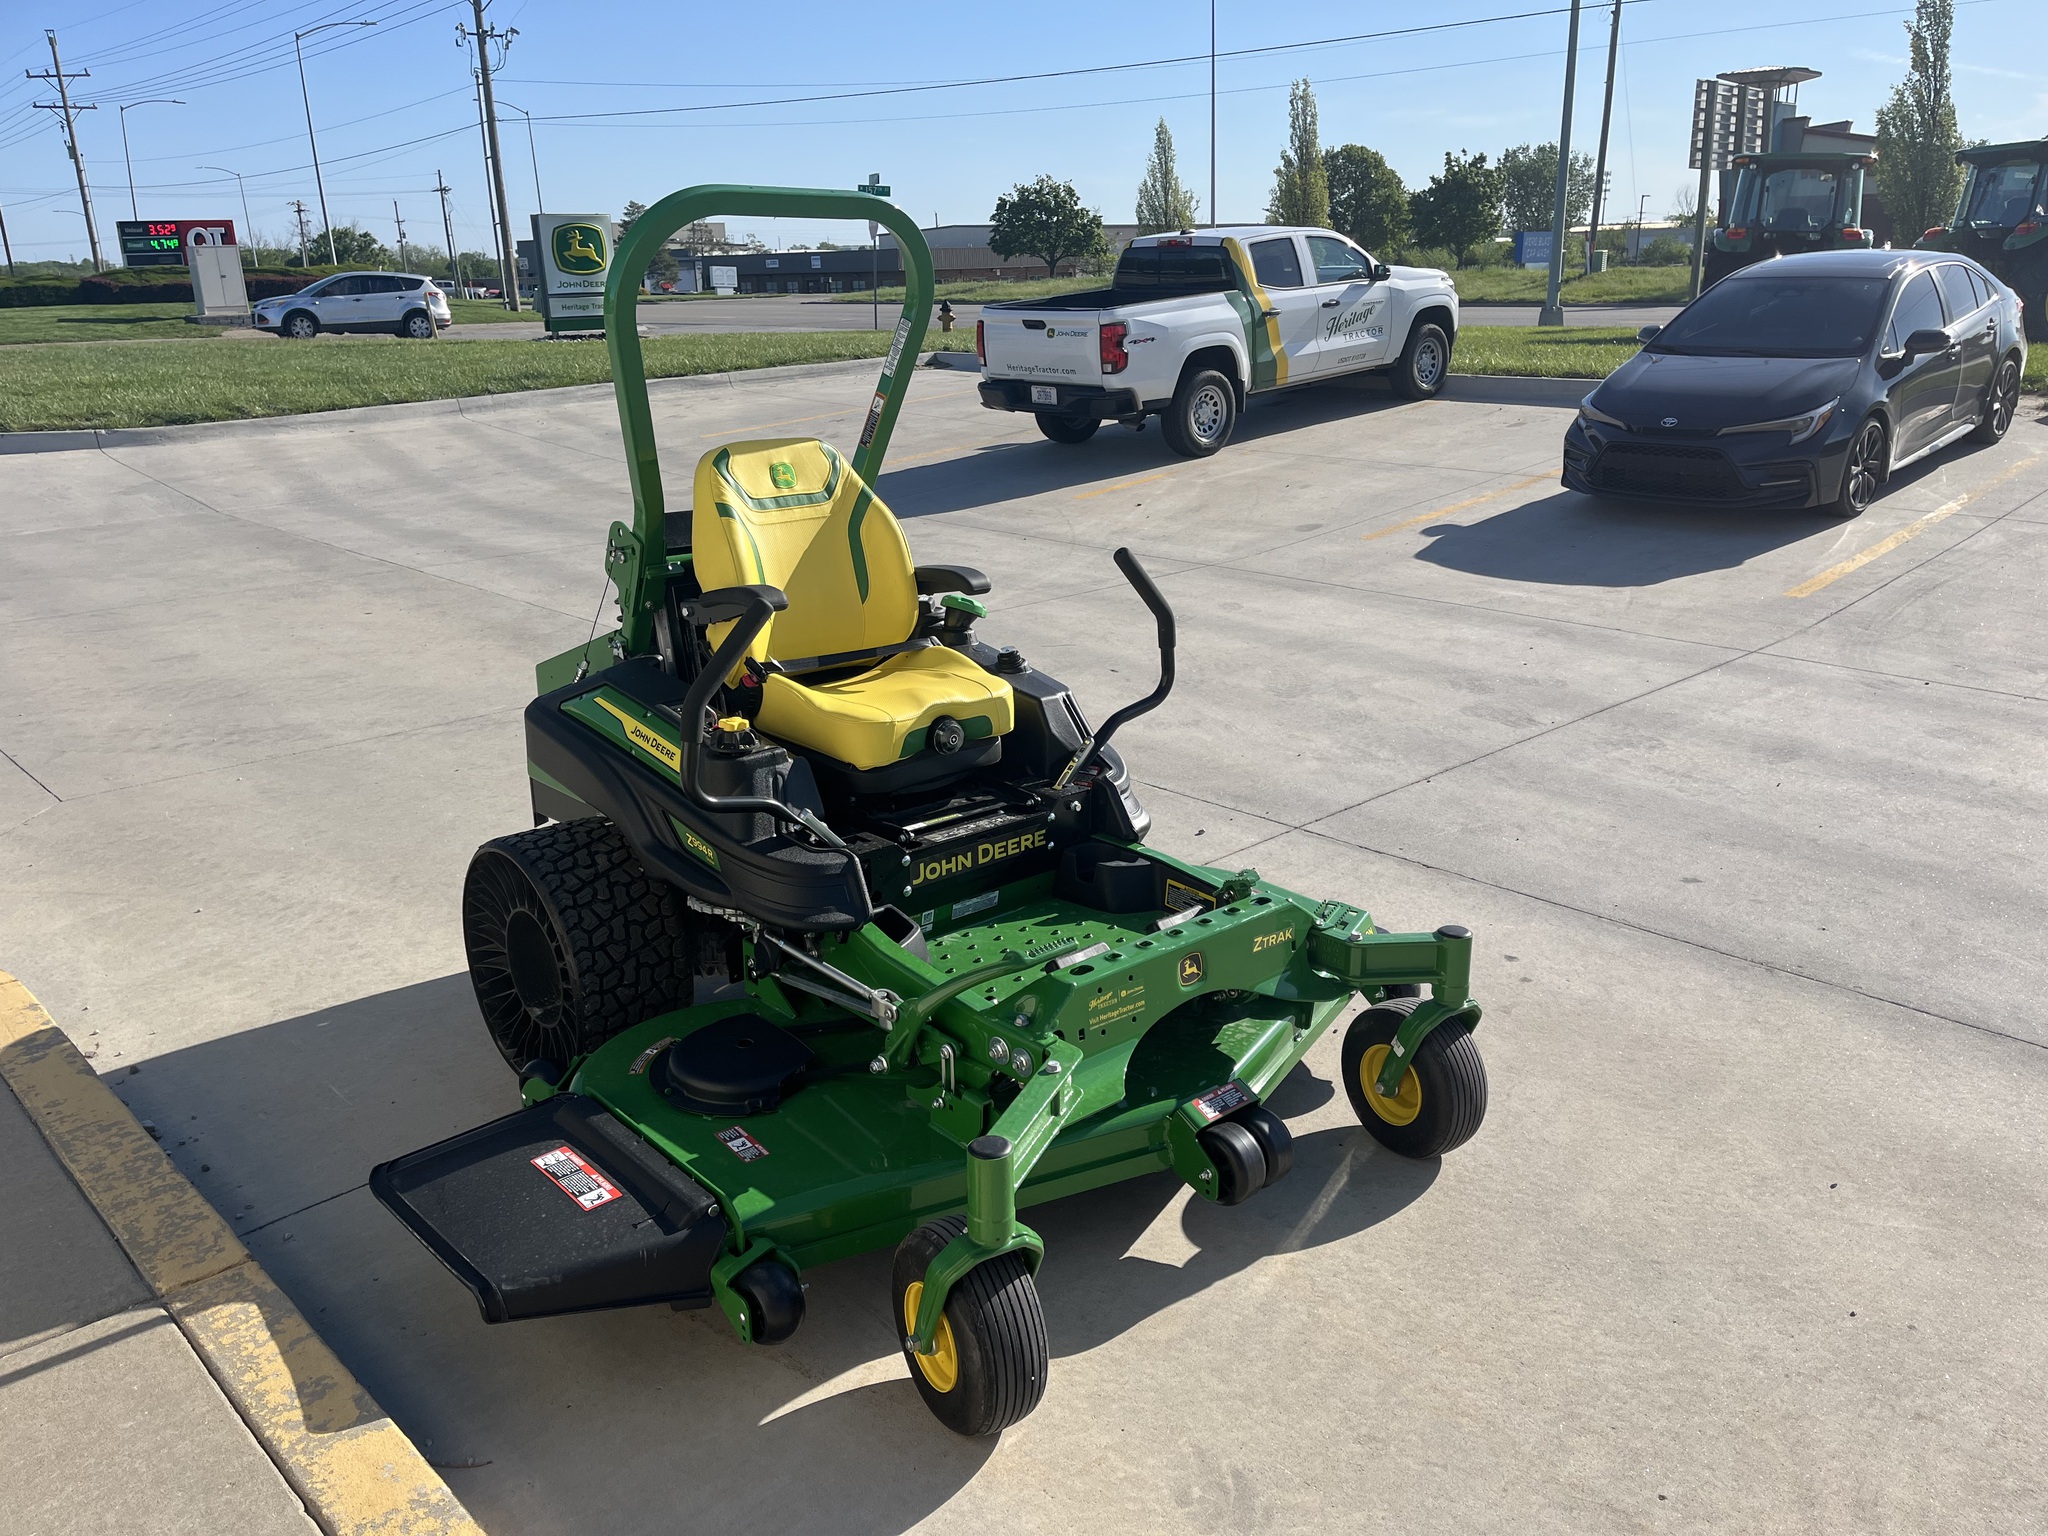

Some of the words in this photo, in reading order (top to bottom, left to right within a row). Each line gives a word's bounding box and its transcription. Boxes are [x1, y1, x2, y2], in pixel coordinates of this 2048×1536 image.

[557, 280, 582, 288] JOHN
[582, 280, 605, 288] DEER
[1324, 305, 1376, 342] Heritage
[1343, 326, 1384, 341] TRACTOR
[1070, 330, 1088, 338] DEERE
[1006, 363, 1077, 376] HeritageTractor.com
[630, 726, 651, 743] JOHN
[650, 737, 676, 761] DEERE
[912, 852, 972, 885] JOHN
[978, 829, 1046, 865] DEERE
[1253, 927, 1294, 953] ZTRAK
